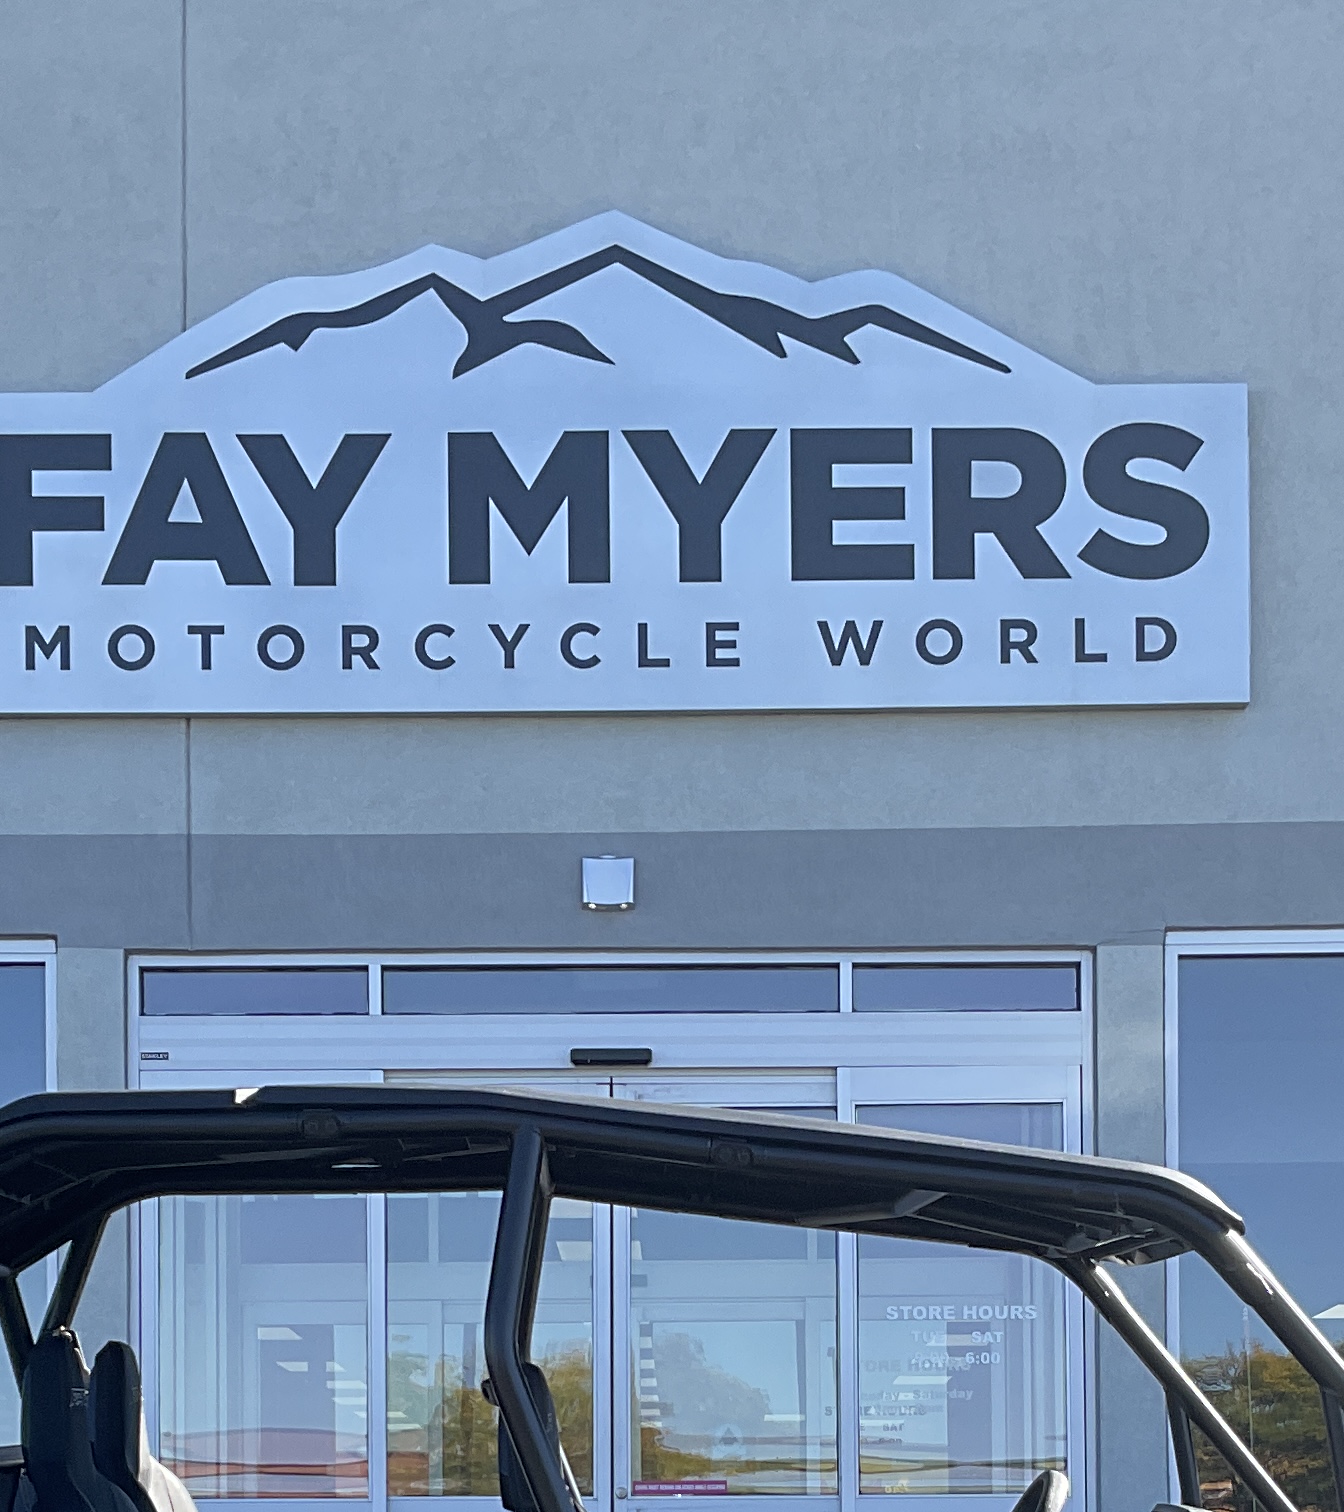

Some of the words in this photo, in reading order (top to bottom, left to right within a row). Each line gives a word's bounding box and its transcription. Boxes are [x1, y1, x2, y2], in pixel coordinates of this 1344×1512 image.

[447, 422, 1211, 585] MYERS
[24, 621, 741, 672] MOTORCYCLE
[816, 616, 1178, 667] WORLD
[886, 1304, 956, 1320] STORE
[962, 1304, 1038, 1320] HOURS
[970, 1330, 1005, 1344] SAT
[965, 1351, 1001, 1365] 6:00
